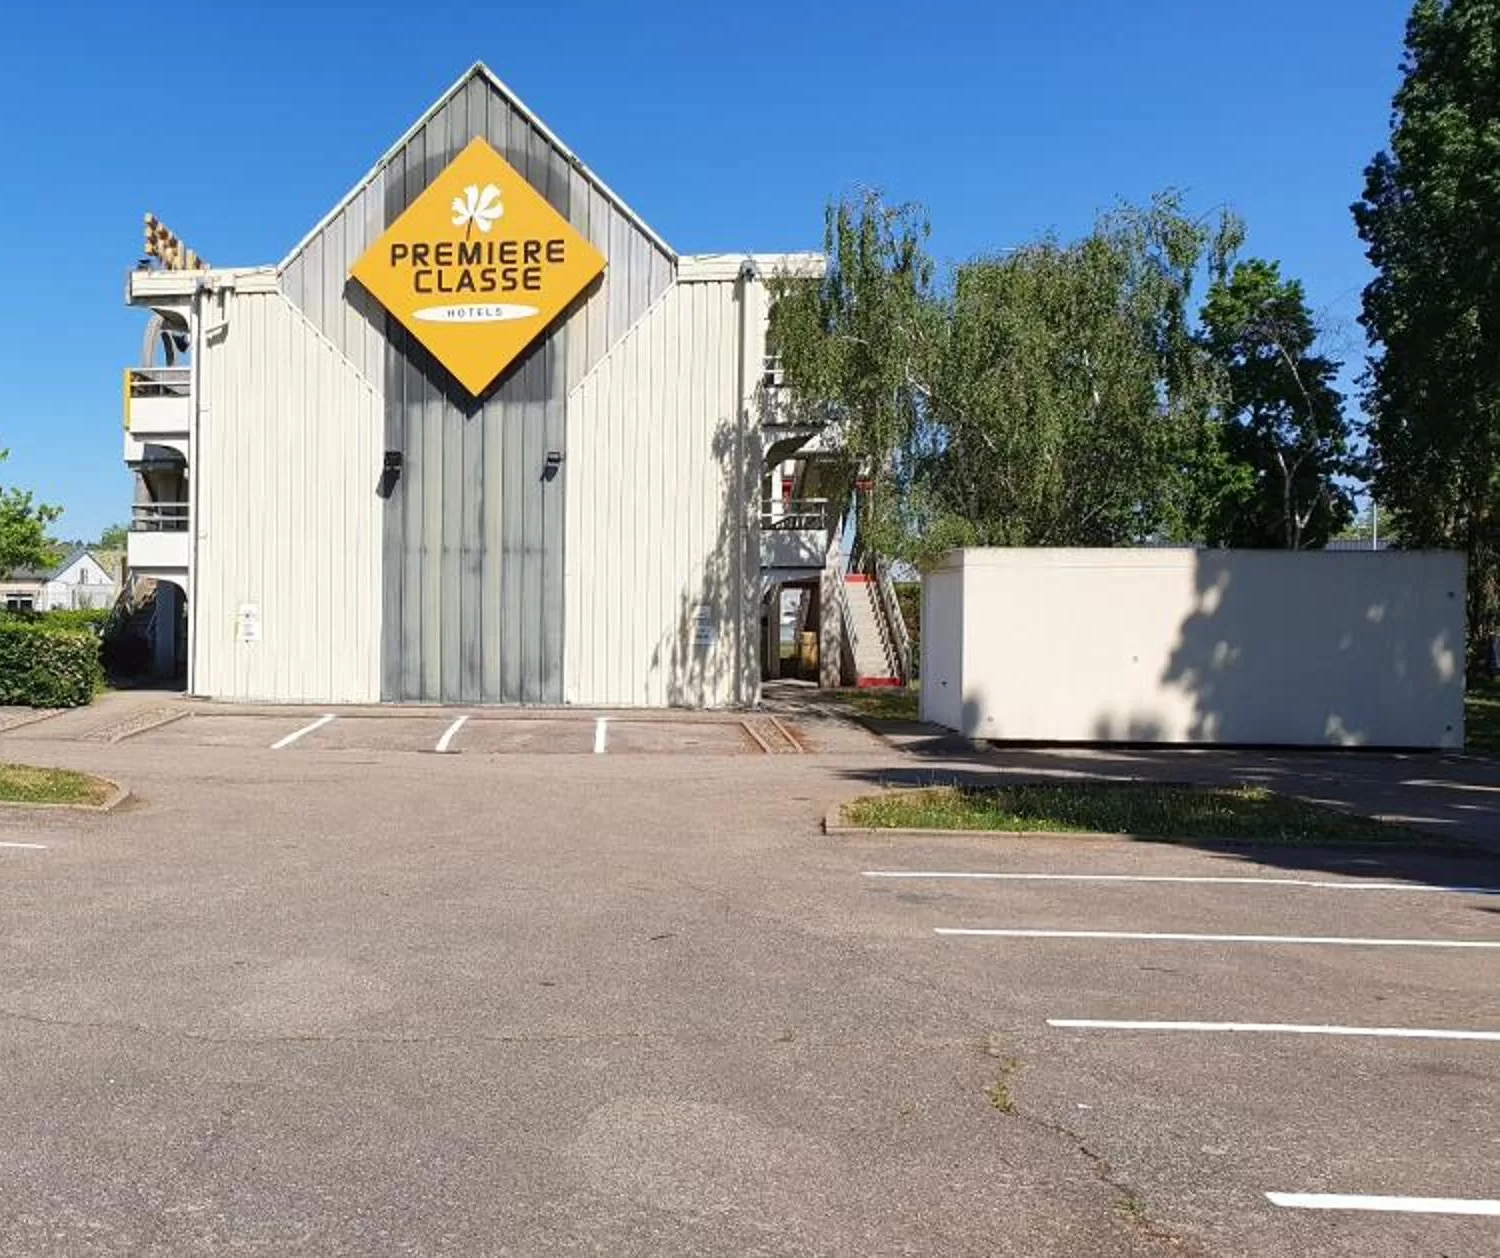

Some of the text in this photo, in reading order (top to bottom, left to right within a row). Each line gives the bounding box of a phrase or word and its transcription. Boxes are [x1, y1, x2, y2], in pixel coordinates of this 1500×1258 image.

[390, 239, 565, 267] PREMIERE
[414, 267, 541, 293] CLASSE
[447, 307, 503, 318] HOTELS
